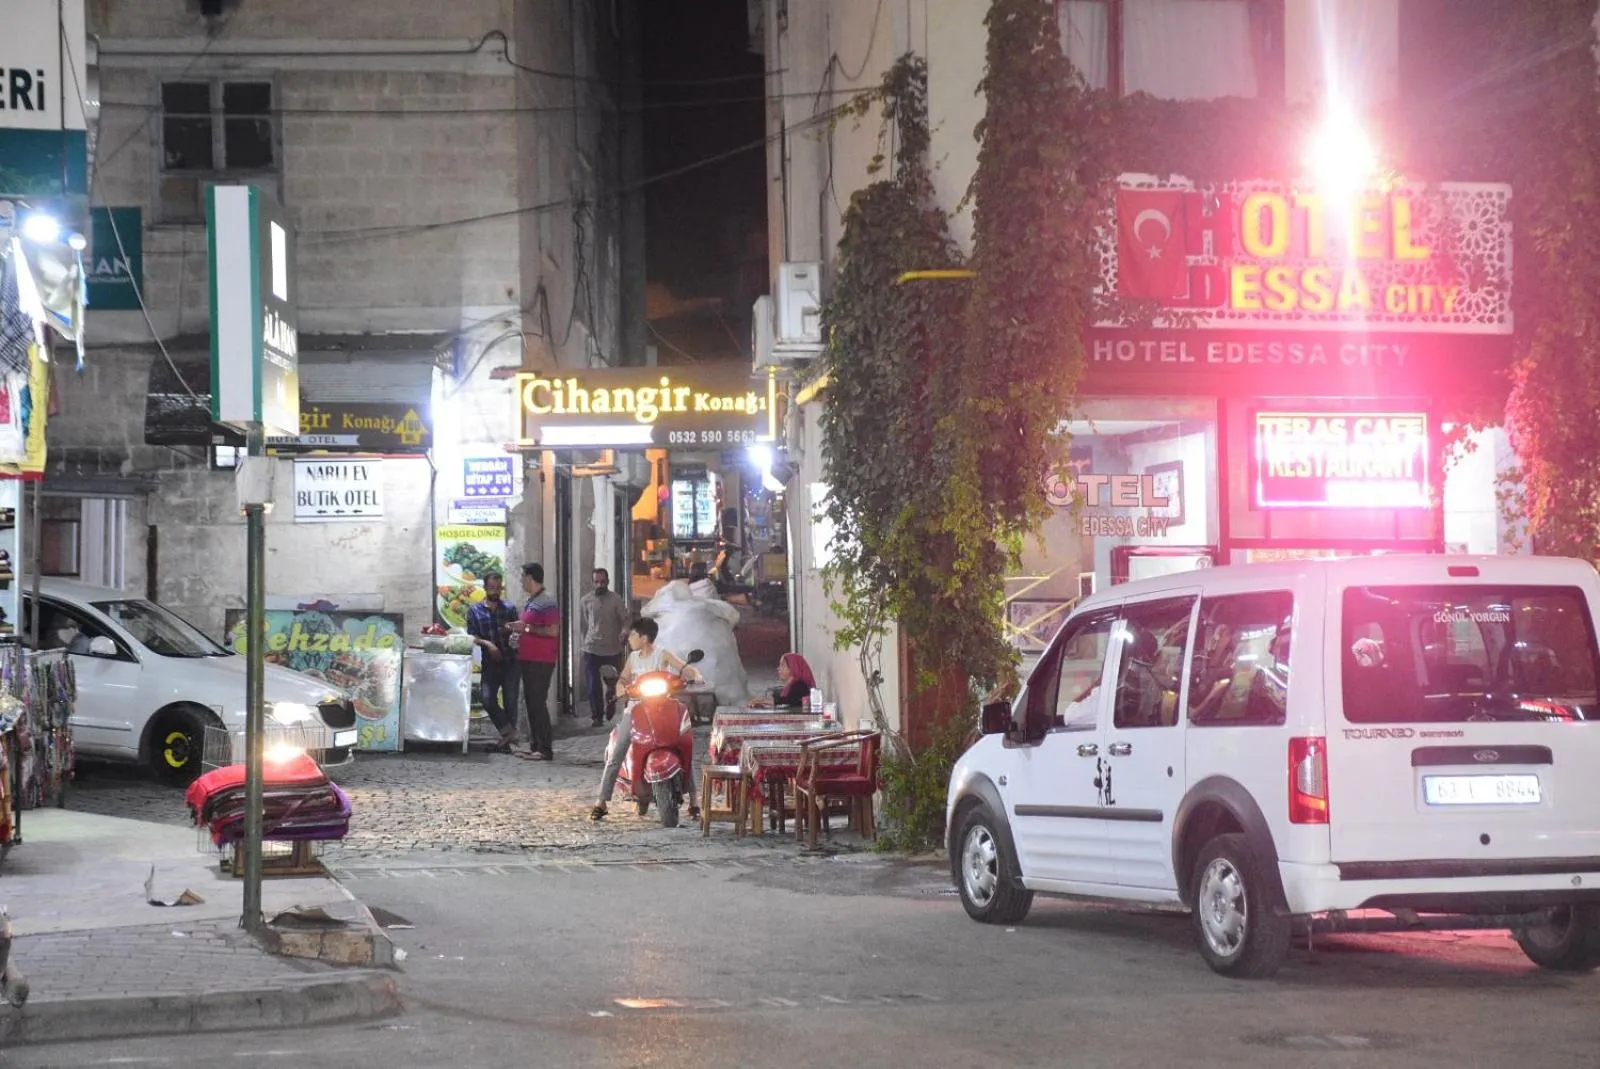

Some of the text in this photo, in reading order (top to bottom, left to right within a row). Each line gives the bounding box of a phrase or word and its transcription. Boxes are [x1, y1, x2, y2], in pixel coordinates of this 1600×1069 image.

[0, 68, 45, 111] Ri
[1385, 284, 1460, 313] CITY
[1093, 340, 1410, 367] HOTEL EDESSA CITY
[522, 376, 767, 423] Cihangir Konağı
[342, 413, 396, 433] Konağı
[308, 436, 338, 444] OTEL
[669, 431, 697, 443] 0532
[701, 430, 722, 442] 590
[353, 465, 370, 481] EV
[345, 489, 380, 507] OTEL
[1081, 516, 1170, 537] EDESSA CITY
[1471, 611, 1511, 624] YORGUN
[1342, 727, 1415, 740] TOURNEO
